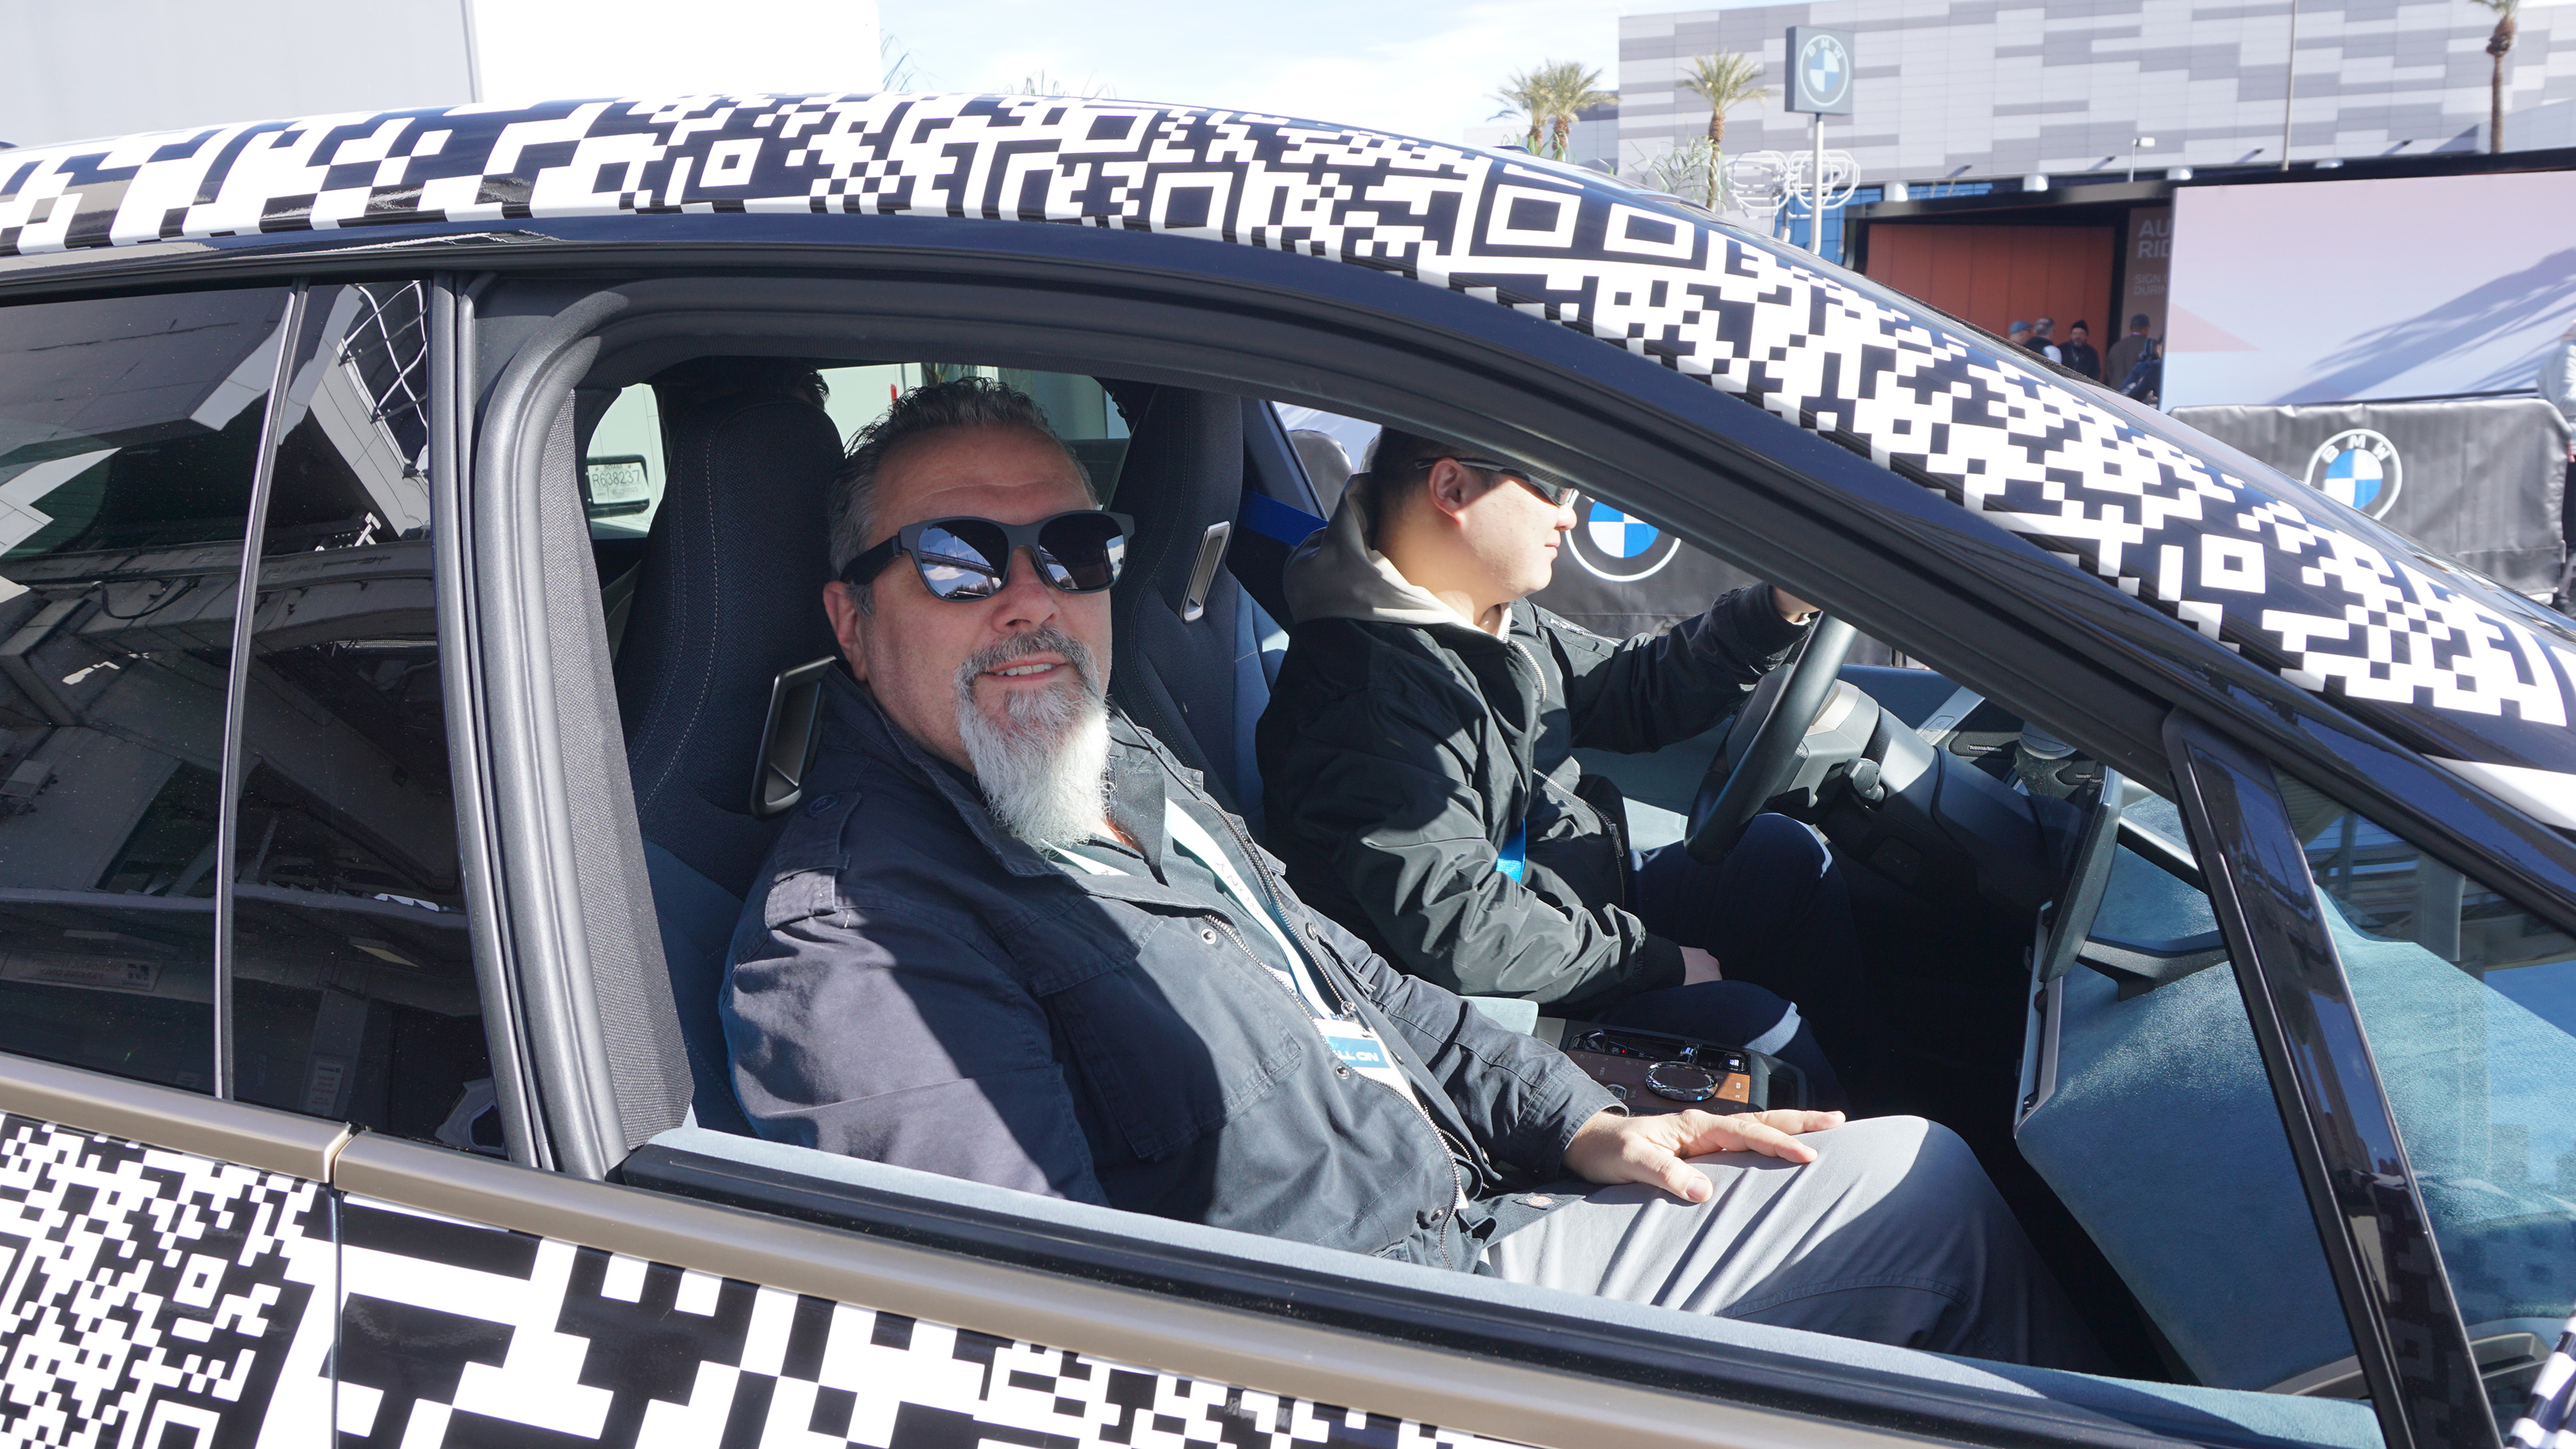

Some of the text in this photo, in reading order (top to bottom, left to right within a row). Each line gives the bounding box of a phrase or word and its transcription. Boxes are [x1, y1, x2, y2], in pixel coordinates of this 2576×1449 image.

[1807, 39, 1843, 59] BMW
[2134, 274, 2161, 284] SIGN
[2322, 435, 2391, 464] BMW
[592, 469, 640, 487] R638237
[1356, 1051, 1380, 1062] ON
